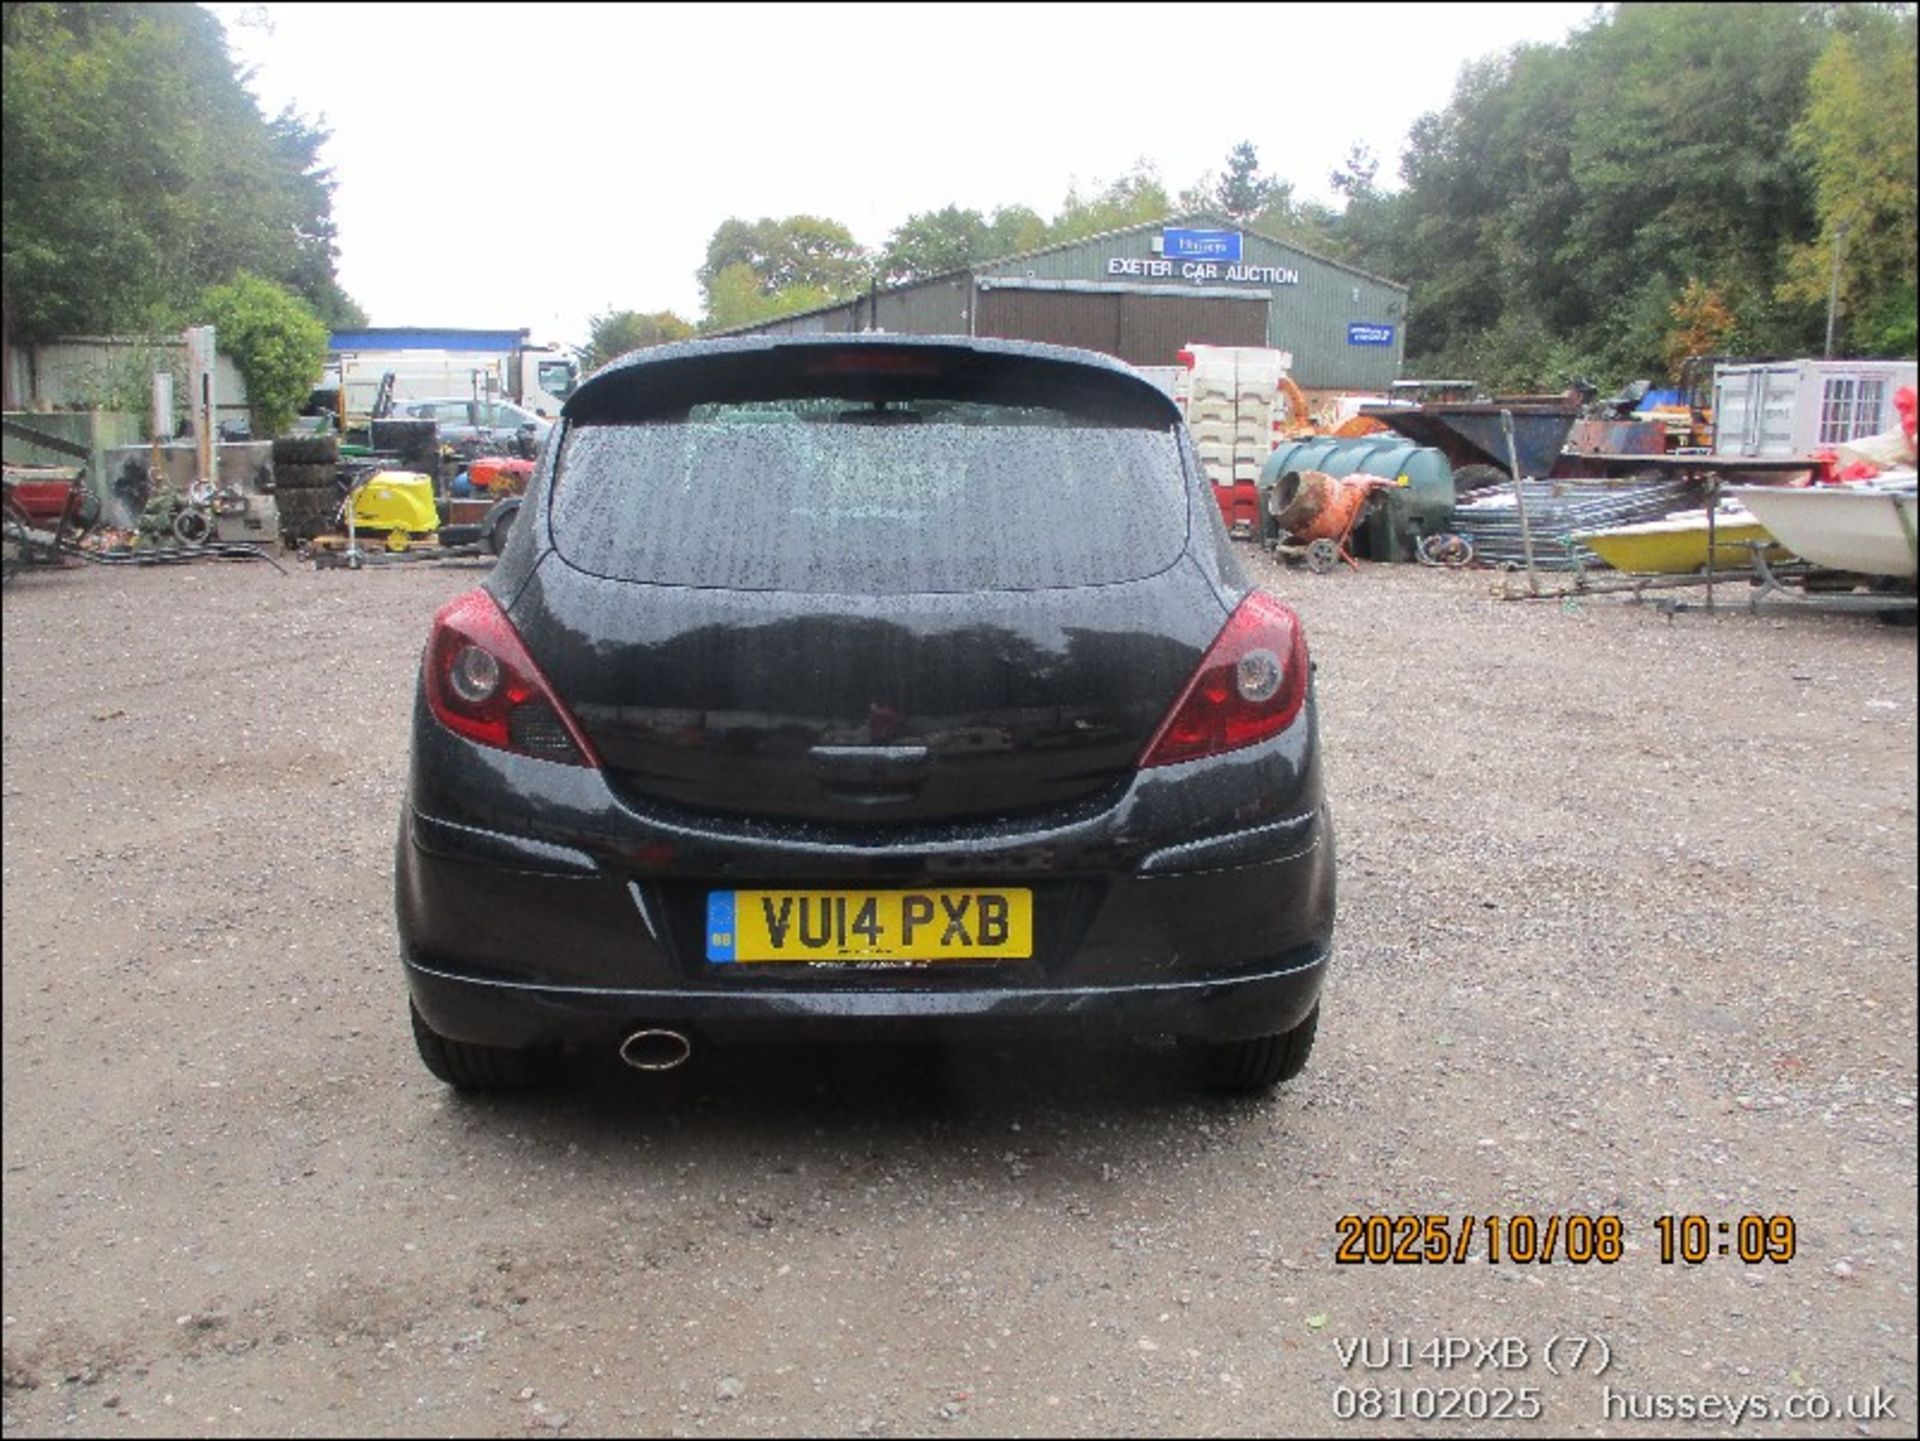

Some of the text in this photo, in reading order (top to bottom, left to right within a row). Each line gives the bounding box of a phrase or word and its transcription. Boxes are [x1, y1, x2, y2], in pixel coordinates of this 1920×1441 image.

[1108, 258, 1299, 284] EXETER CAR AUCTION
[761, 896, 1010, 949] VU14 PXB
